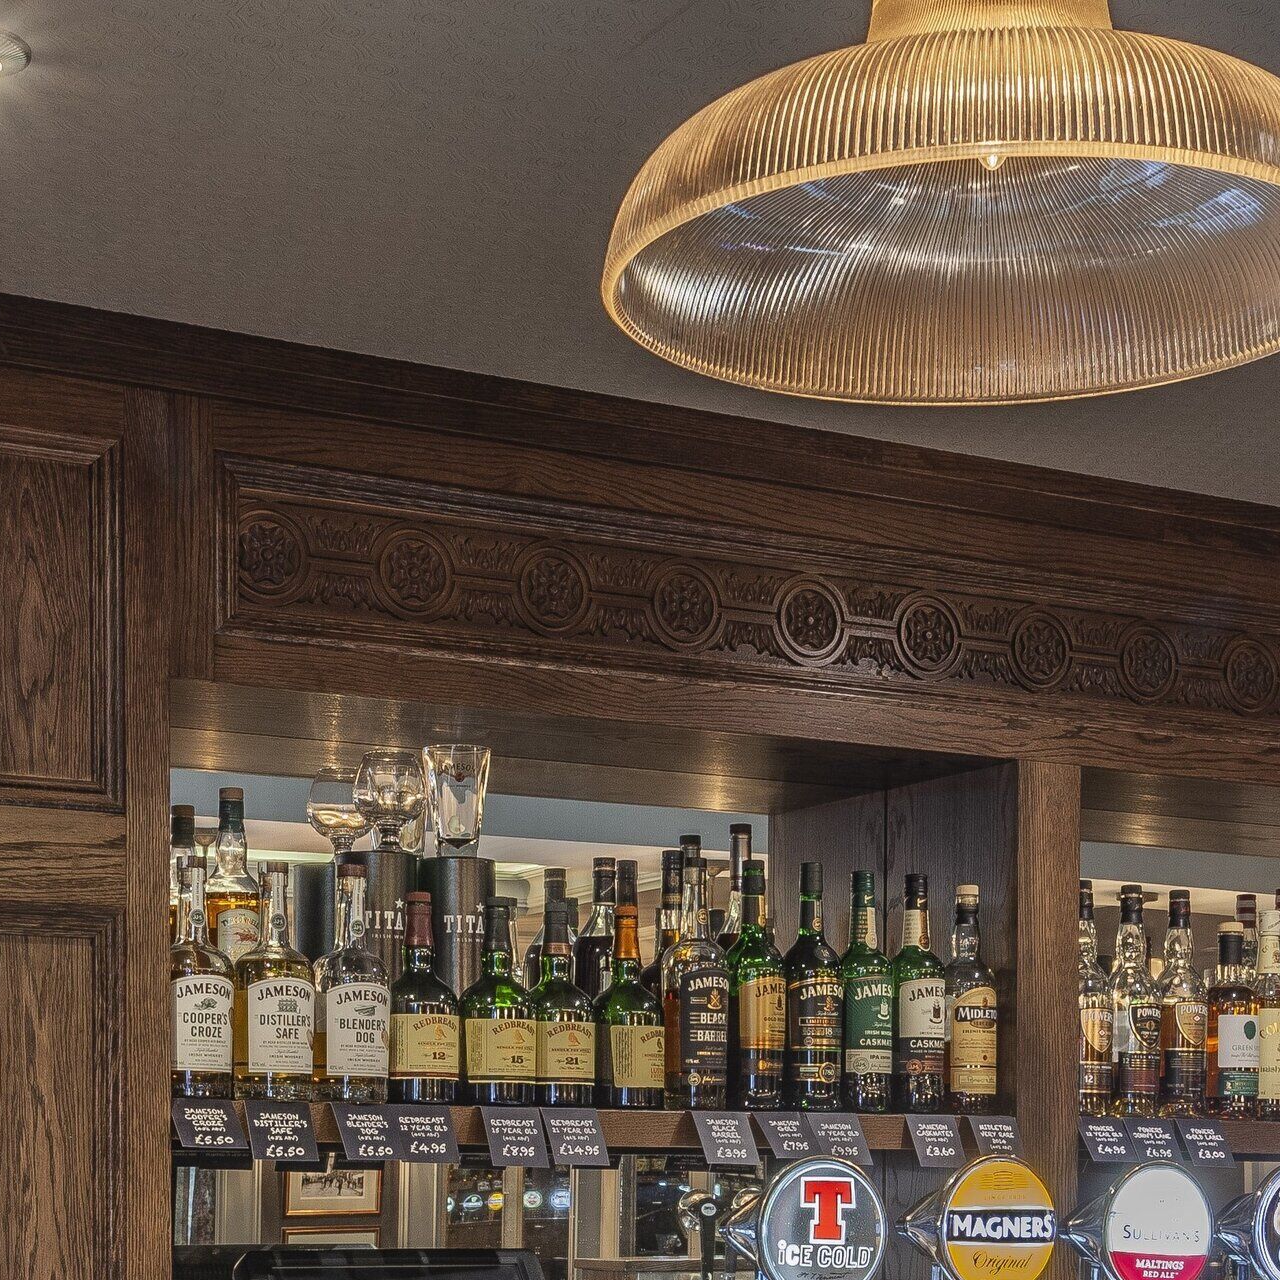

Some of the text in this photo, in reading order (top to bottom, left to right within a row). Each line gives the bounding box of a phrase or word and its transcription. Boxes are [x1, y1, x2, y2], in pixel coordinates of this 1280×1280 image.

[365, 911, 404, 930] TITA
[444, 915, 485, 934] TITA
[688, 976, 729, 992] JAMESO
[177, 983, 231, 1000] JAMESON
[257, 985, 311, 1002] JAMESON
[800, 984, 843, 1000] JAMESO
[854, 983, 892, 1000] JAMES
[909, 986, 945, 1001] JAMES
[336, 990, 388, 1007] JAMESON
[183, 1012, 228, 1025] COOPER'S
[958, 1007, 997, 1020] MIDLETO
[260, 1014, 311, 1028] DISTILLER'S
[339, 1018, 386, 1032] BLENDER'S
[413, 1016, 457, 1032] REDBREAST
[191, 1026, 223, 1038] CROZE
[275, 1027, 300, 1040] SAFE
[492, 1020, 535, 1036] REDBREAST
[547, 1023, 593, 1040] REDBREAST
[356, 1032, 375, 1043] DOG
[432, 1051, 446, 1060] 12
[511, 1055, 524, 1064] 15
[565, 1056, 579, 1066] 21
[1084, 1075, 1093, 1083] 12
[184, 1113, 228, 1121] COOPER'S
[253, 1119, 308, 1127] DISTILLER'S
[348, 1113, 383, 1121] JAMESON
[399, 1116, 445, 1124] REDBREAST
[490, 1119, 535, 1127] REDBREAST
[271, 1127, 293, 1135] SAFE
[410, 1124, 432, 1132] YEAR
[916, 1130, 954, 1138] CASKMATES
[979, 1124, 1012, 1132] MIDLETON
[195, 1134, 234, 1145] £5.50
[711, 1131, 741, 1139] BARREL
[266, 1144, 306, 1157] £5.50
[359, 1144, 394, 1157] £5.50
[410, 1141, 447, 1154] £4.95
[502, 1144, 535, 1157] £8.95
[560, 1143, 600, 1155] £14.95
[783, 1140, 809, 1151] £7.95
[831, 1145, 858, 1156] £9.95
[926, 1145, 956, 1157] £3.60
[1097, 1144, 1126, 1155] £4.95
[717, 1147, 747, 1158] £3.95
[1146, 1147, 1172, 1158] £6.95
[1198, 1148, 1226, 1159] £3.00
[800, 1176, 856, 1245] T
[952, 1213, 1054, 1240] MAGNERS
[817, 1245, 871, 1269] COLD
[972, 1250, 1033, 1275] Original
[1135, 1258, 1184, 1270] MALTINGS
[1143, 1270, 1175, 1279] RED ALE
